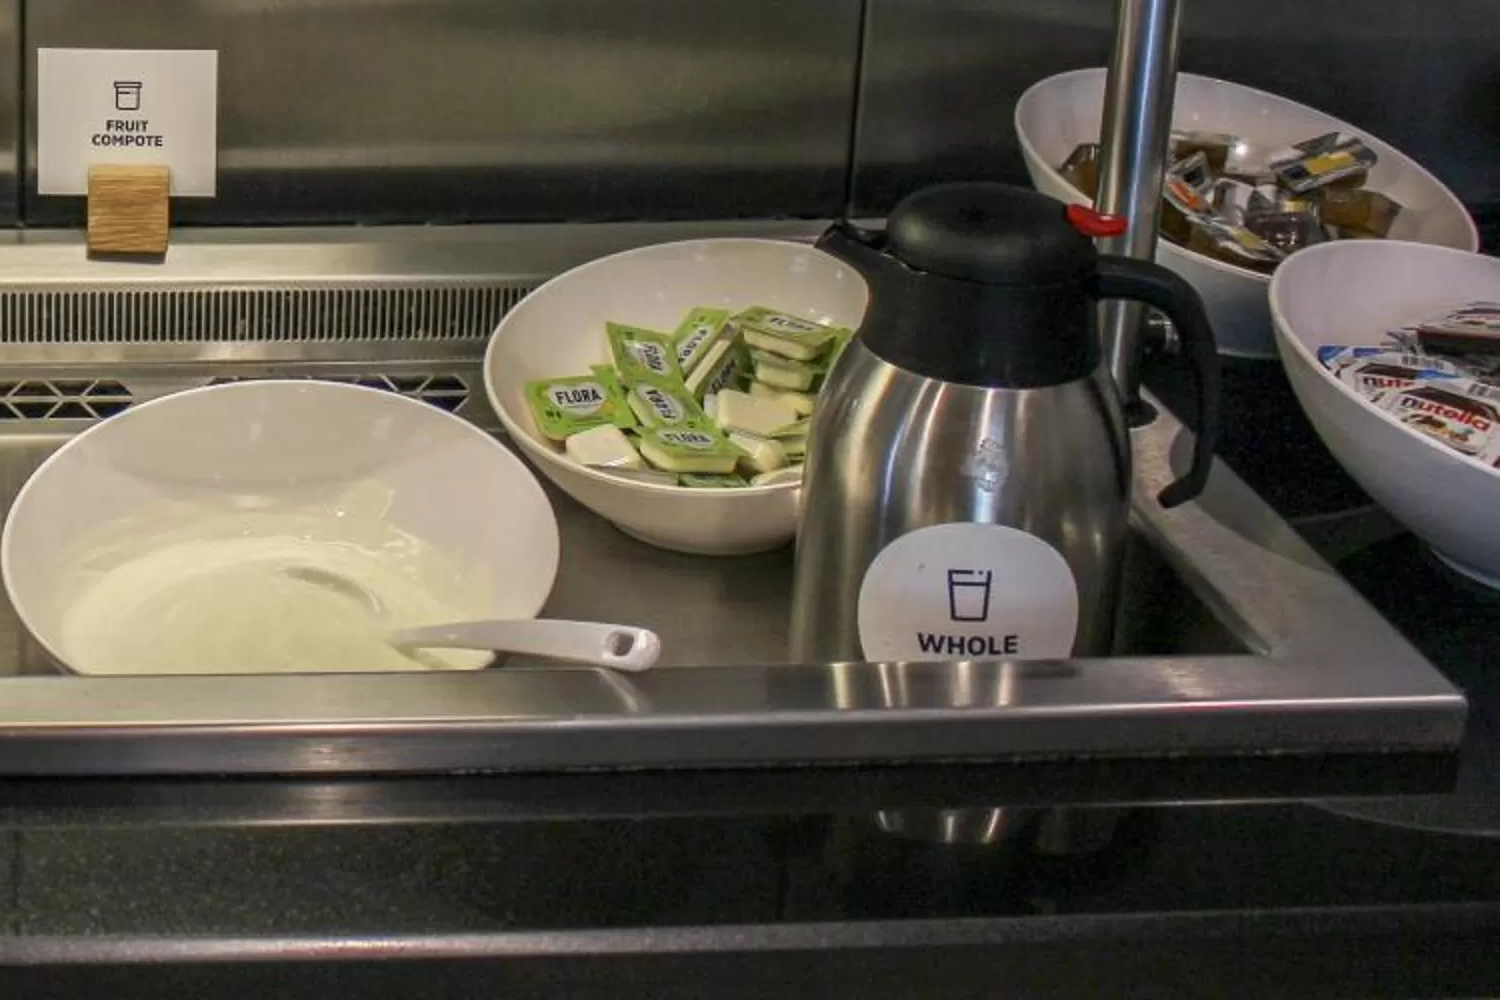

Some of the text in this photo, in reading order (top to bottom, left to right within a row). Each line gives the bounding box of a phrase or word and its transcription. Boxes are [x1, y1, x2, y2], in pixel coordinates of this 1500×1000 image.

[106, 119, 149, 132] FRUIT
[91, 134, 163, 147] COMPOTE
[554, 388, 603, 405] FLORA
[1401, 397, 1491, 432] nutella
[917, 632, 1020, 655] WHOLE
